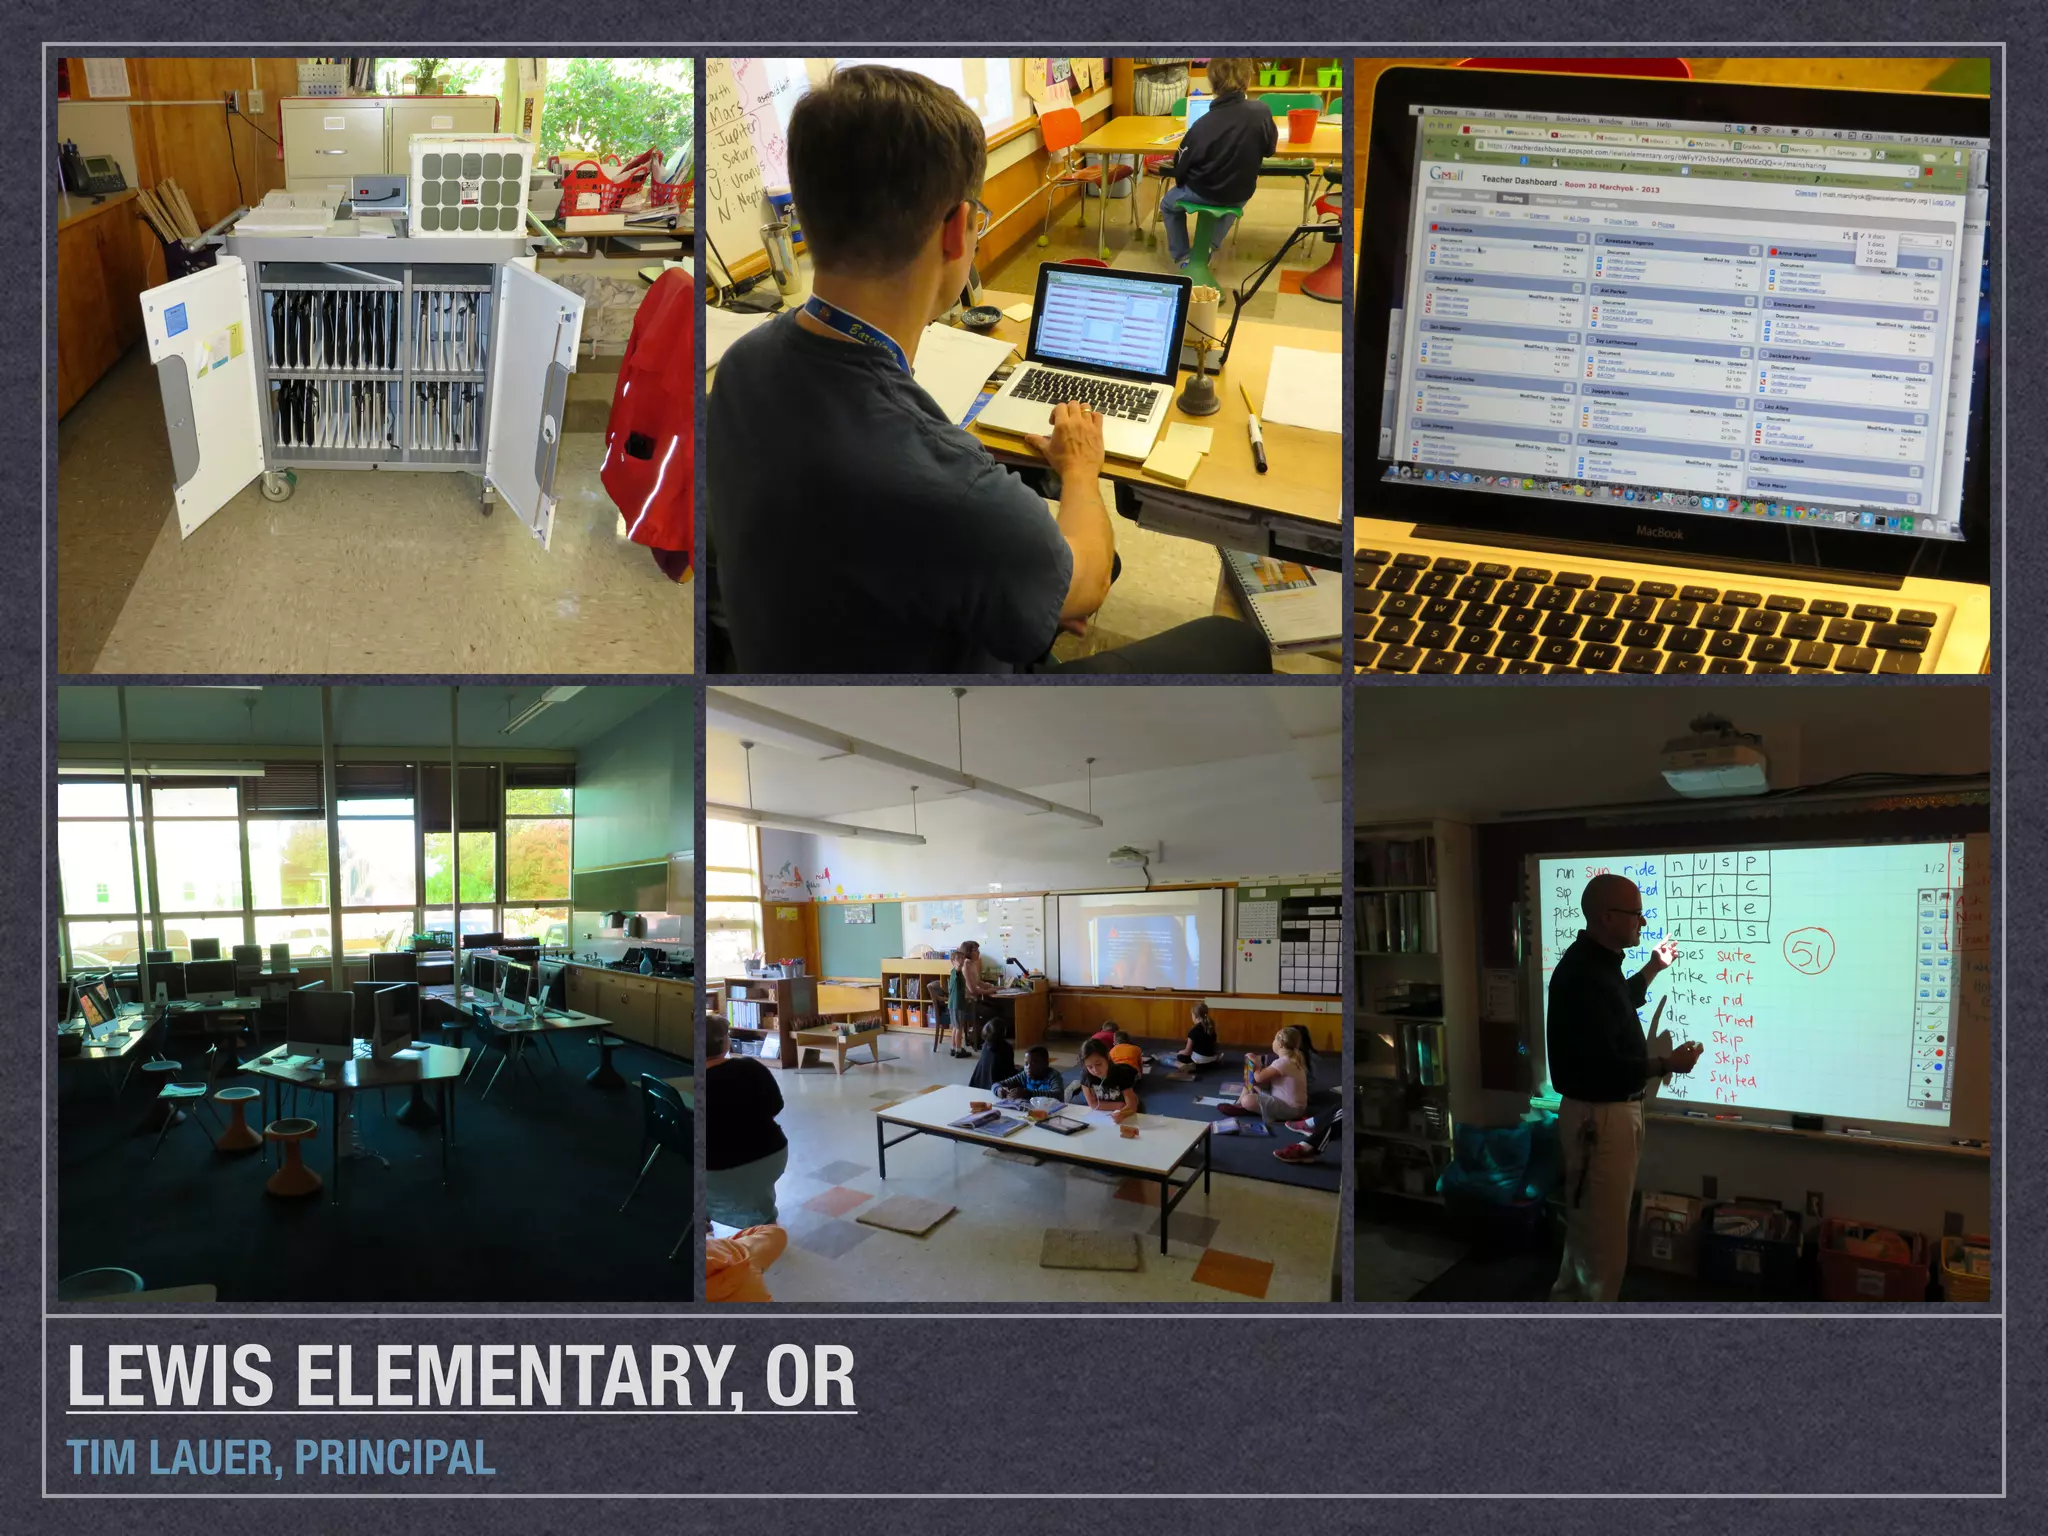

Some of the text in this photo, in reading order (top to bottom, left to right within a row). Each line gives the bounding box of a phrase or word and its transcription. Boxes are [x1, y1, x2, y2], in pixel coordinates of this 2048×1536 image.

[709, 101, 744, 127] Mars
[1556, 115, 1591, 124] Bookmarks
[1598, 118, 1623, 126] Window
[715, 119, 757, 147] Jupiter
[1950, 138, 1978, 146] Teacher
[722, 145, 758, 169] Saturn
[730, 160, 766, 189] Uranus
[1482, 174, 1513, 184] Teacher
[1515, 176, 1558, 187] Dashboard
[1564, 181, 1586, 189] Room
[1599, 184, 1634, 193] Marchyok
[1932, 199, 1944, 207] Log
[1636, 525, 1684, 540] MacBook
[1899, 637, 1922, 645] delete
[1624, 861, 1657, 877] ride
[1673, 859, 1684, 872] n
[1722, 857, 1730, 867] s
[1746, 856, 1757, 872] p
[1924, 863, 1945, 874] 1/2
[1671, 880, 1683, 897] h
[1697, 883, 1708, 894] r
[1553, 906, 1580, 929] picks
[1697, 901, 1709, 916] t
[1722, 901, 1732, 916] k
[1744, 902, 1757, 915] e
[1673, 922, 1682, 938] d
[1697, 925, 1708, 936] e
[1747, 925, 1757, 937] s
[1628, 946, 1650, 961] sit
[1717, 947, 1756, 965] suite
[1792, 940, 1821, 969] 51
[1670, 968, 1754, 985] trike dirt
[1672, 986, 1743, 1007] trikes rid
[1666, 1006, 1754, 1029] die tried
[1712, 1030, 1744, 1053] skip
[1714, 1050, 1751, 1073] skips
[1710, 1070, 1758, 1089] suited
